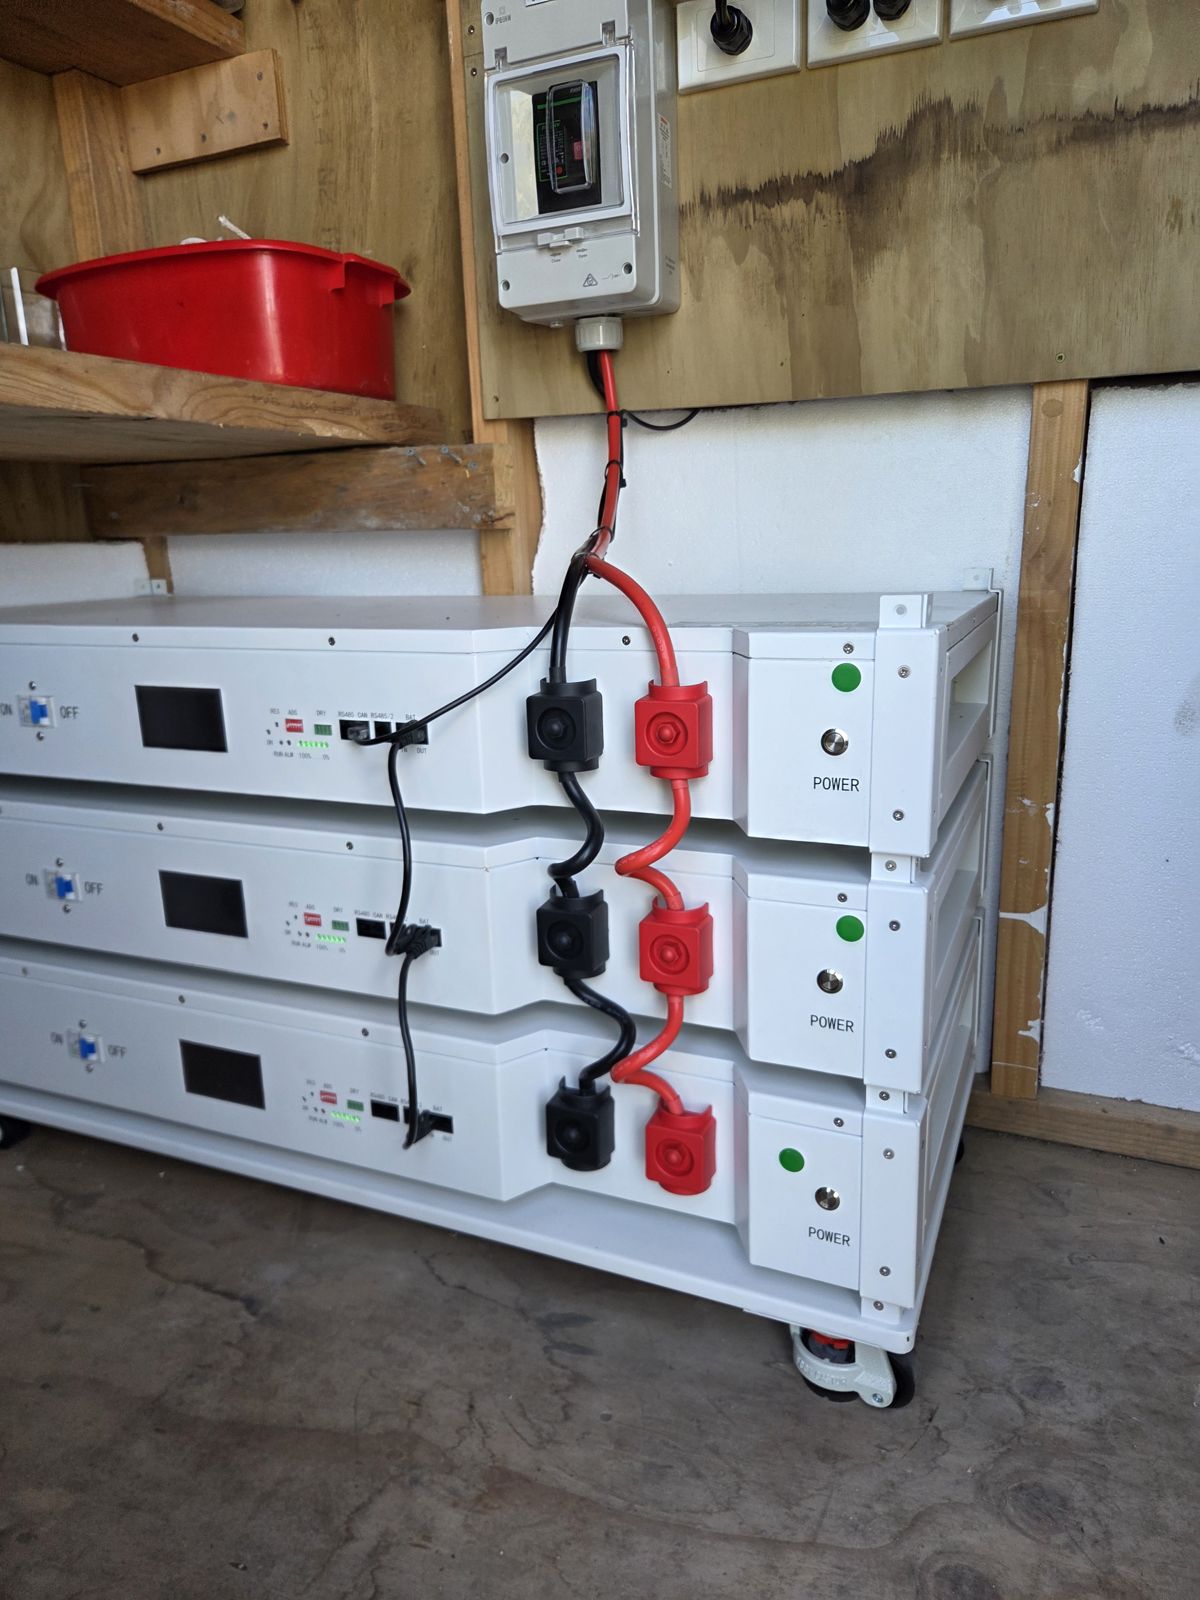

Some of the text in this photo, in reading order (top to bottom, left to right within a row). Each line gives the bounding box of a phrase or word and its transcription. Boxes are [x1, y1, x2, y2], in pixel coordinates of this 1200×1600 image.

[60, 705, 79, 719] OFF
[813, 776, 860, 792] POWER
[25, 873, 39, 886] ON
[84, 881, 103, 895] OFF
[810, 1014, 854, 1033] POWER
[107, 1045, 127, 1058] OFF
[808, 1226, 850, 1247] POWER
